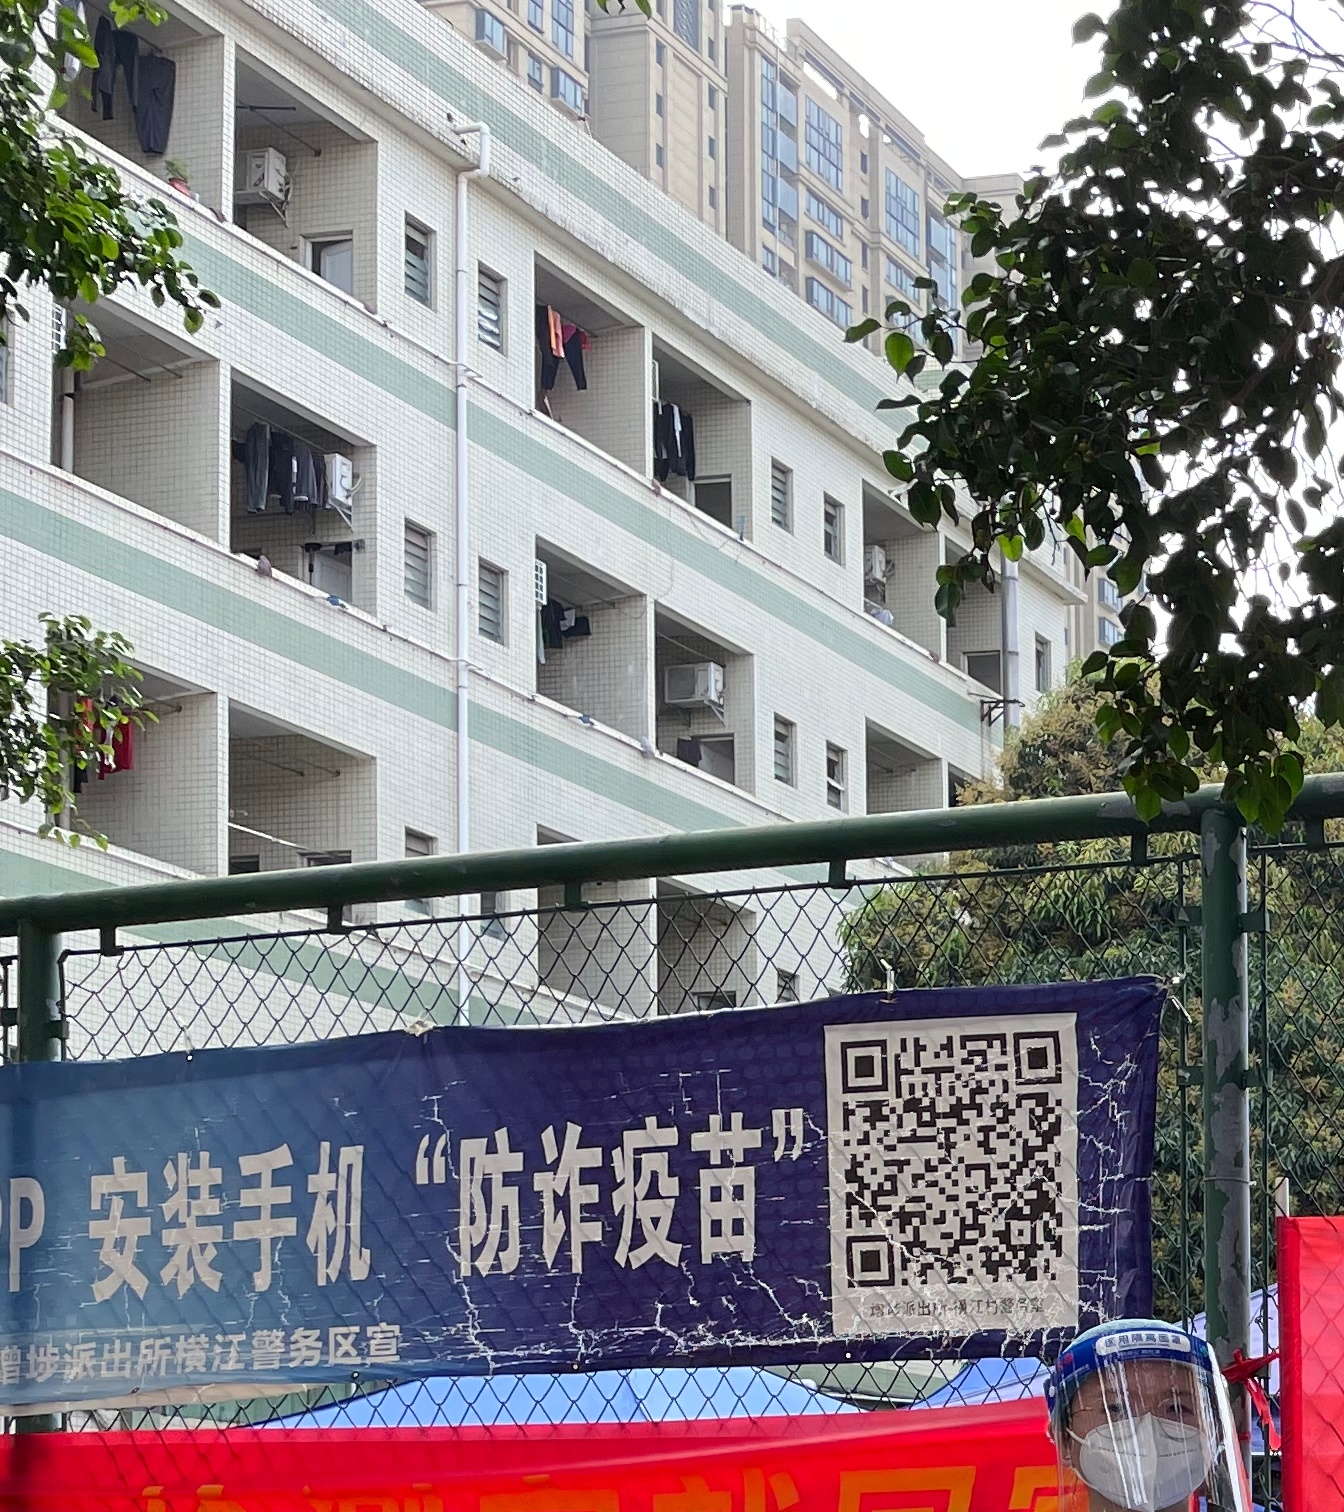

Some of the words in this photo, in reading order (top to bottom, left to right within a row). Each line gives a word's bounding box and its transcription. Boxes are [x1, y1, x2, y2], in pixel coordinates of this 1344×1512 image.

[0, 1177, 45, 1292] P
[1104, 1332, 1182, 1348] 医用隔离面罩
